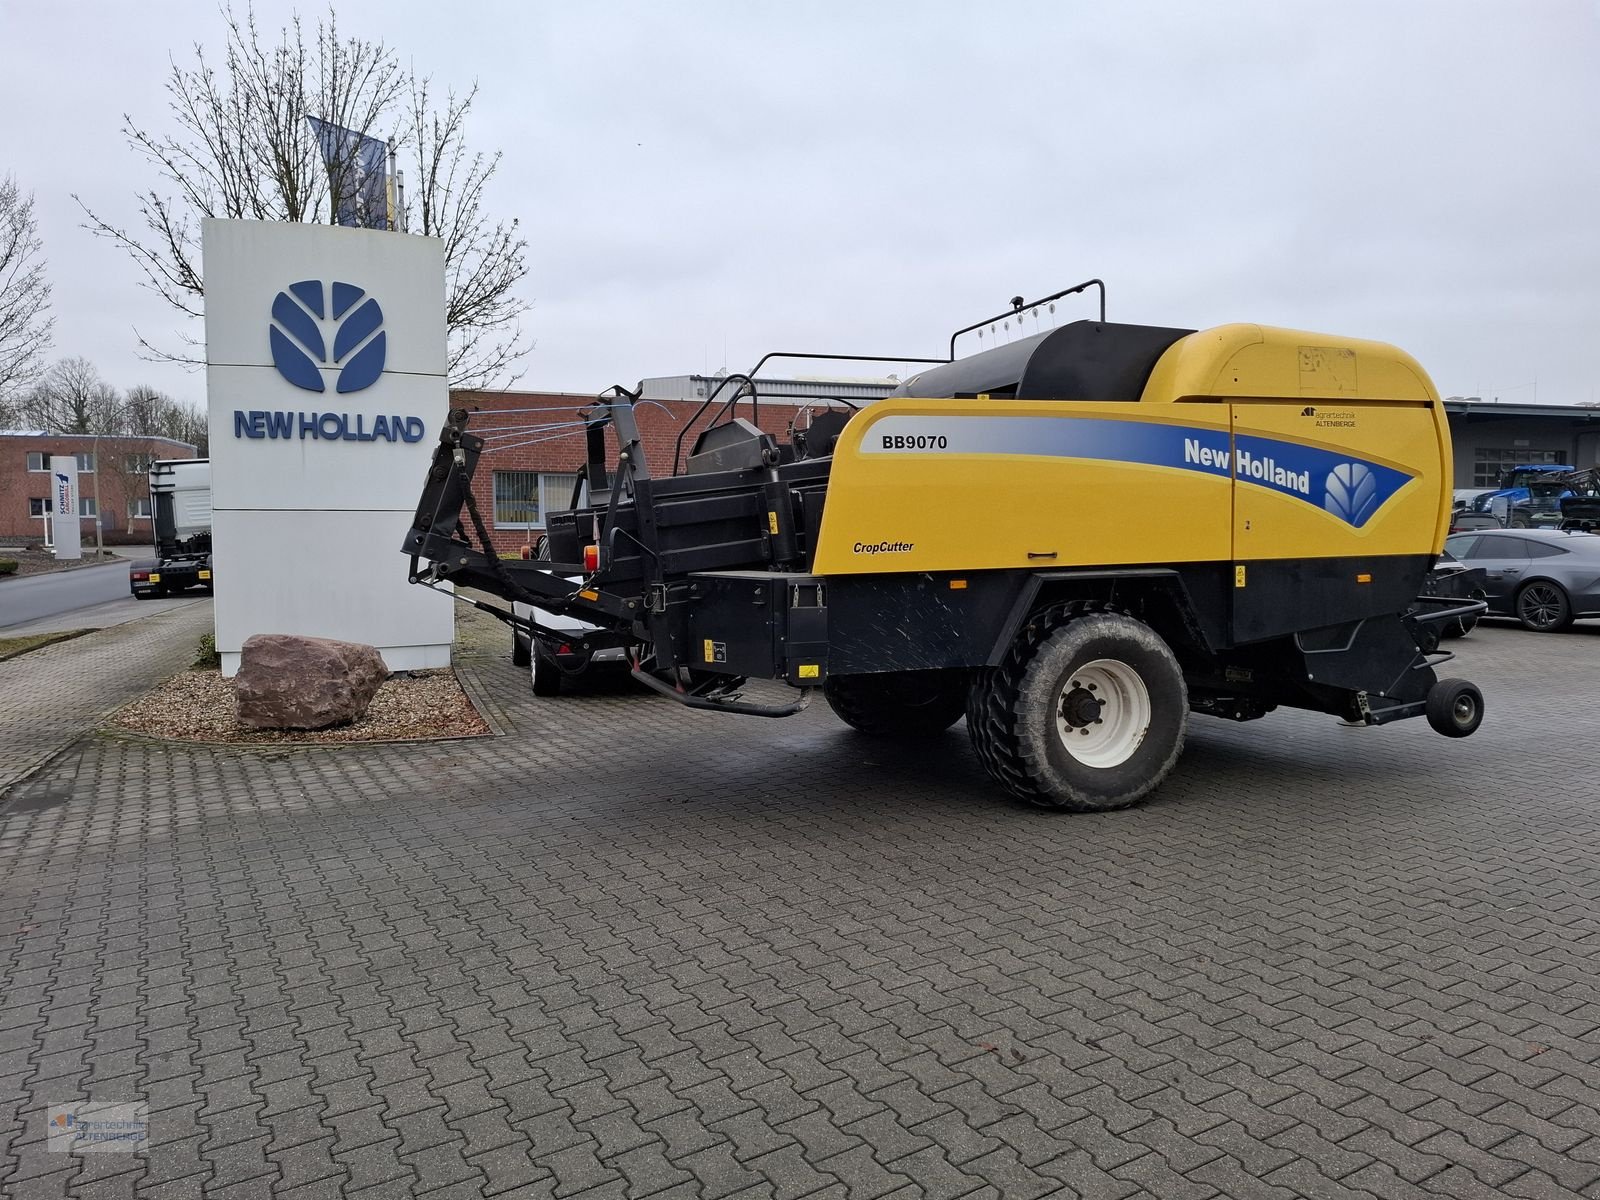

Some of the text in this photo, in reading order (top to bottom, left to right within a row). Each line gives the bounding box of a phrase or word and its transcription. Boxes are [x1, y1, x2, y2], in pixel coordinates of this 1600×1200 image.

[234, 411, 425, 442] NEW HOLLAND
[1315, 420, 1356, 428] ALTENBERGE
[882, 435, 947, 449] BB9070
[1184, 438, 1310, 494] New Holland
[853, 541, 914, 555] CropCutter
